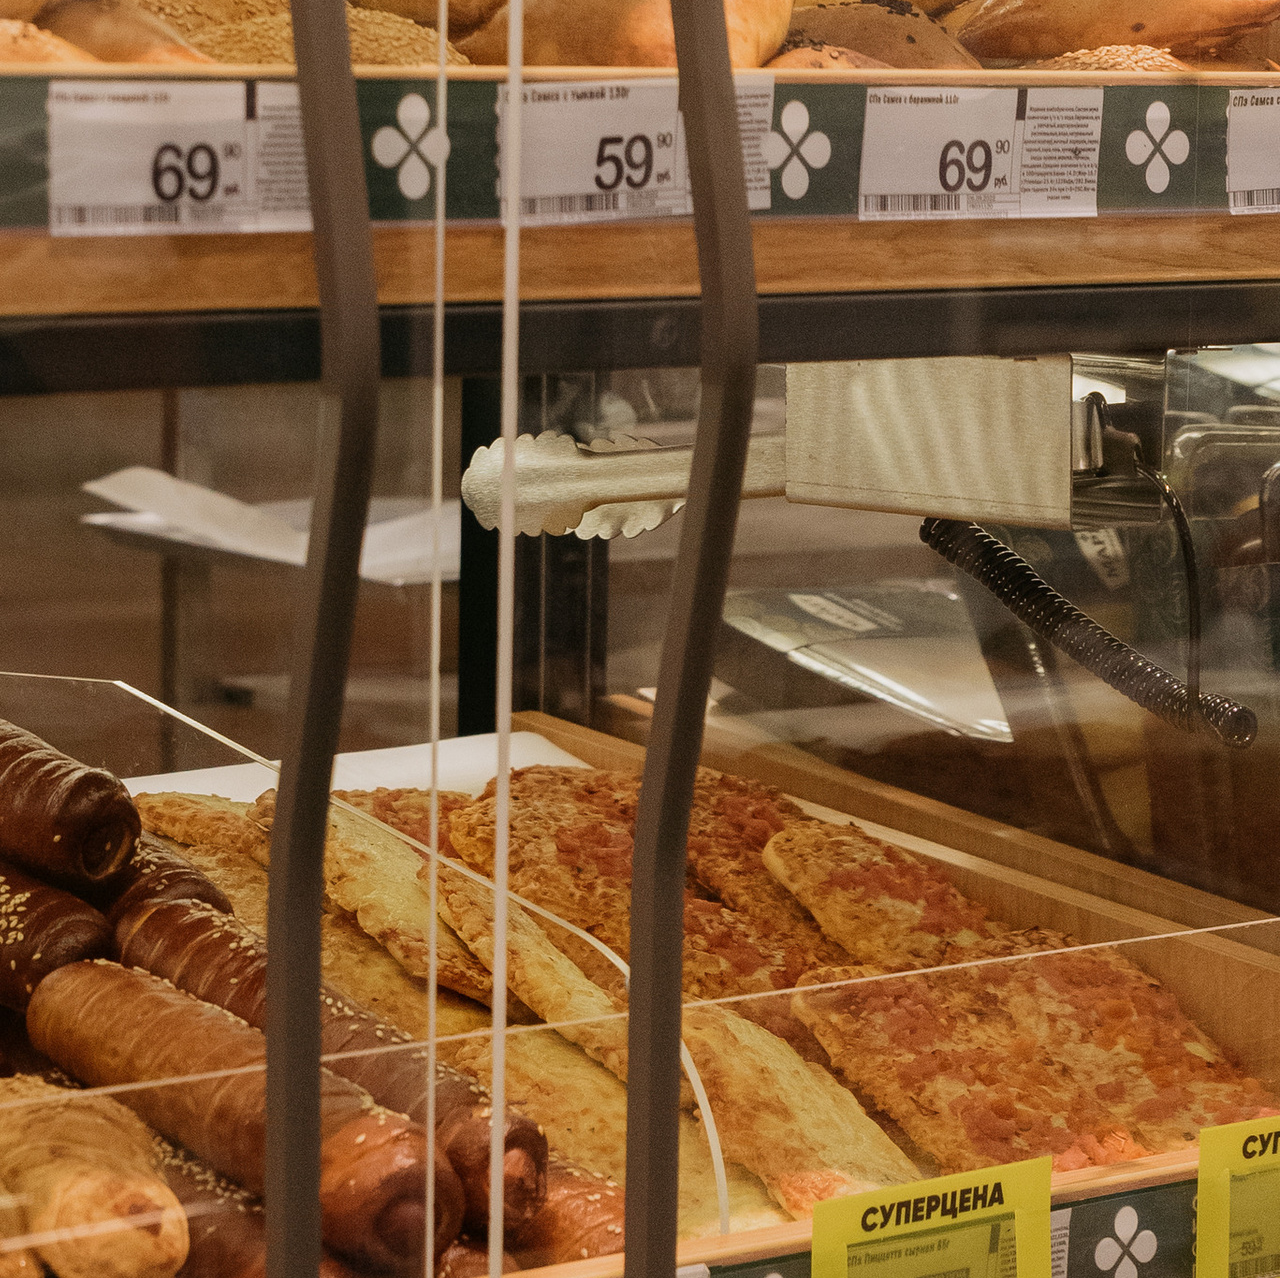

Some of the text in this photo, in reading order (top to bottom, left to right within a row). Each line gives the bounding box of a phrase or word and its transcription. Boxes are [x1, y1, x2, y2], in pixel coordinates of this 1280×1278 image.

[1250, 95, 1274, 106] Самса
[152, 142, 219, 203] 69
[594, 134, 654, 191] 59
[938, 139, 993, 192] 69
[995, 140, 1010, 154] 90
[861, 1182, 1005, 1232] СУПЕРЦЕНА
